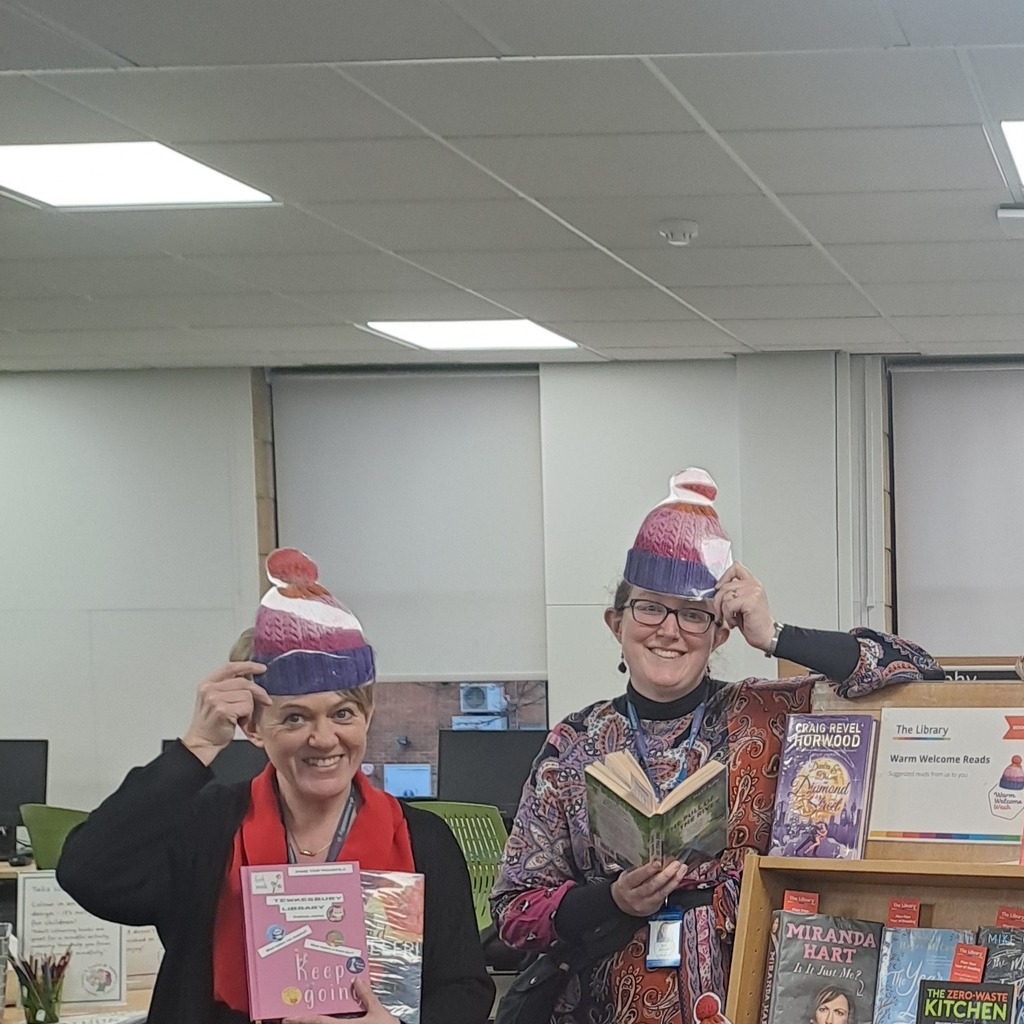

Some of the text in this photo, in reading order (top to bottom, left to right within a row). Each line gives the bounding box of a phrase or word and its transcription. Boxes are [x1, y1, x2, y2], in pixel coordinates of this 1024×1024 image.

[795, 722, 861, 733] CRAIG REVEL
[896, 725, 949, 737] The Library
[794, 734, 861, 748] HORWOOD
[890, 755, 990, 764] Warm Welcome Reads
[786, 923, 877, 948] MIRANDA
[988, 933, 1016, 944] MIKE
[803, 943, 857, 964] HART
[295, 953, 345, 984] Keep
[763, 951, 776, 1001] MIRANDA
[793, 962, 862, 981] Is It Just Me?
[927, 988, 1009, 1003] THE ZERO-WASTE
[924, 999, 1008, 1021] KITCHEN
